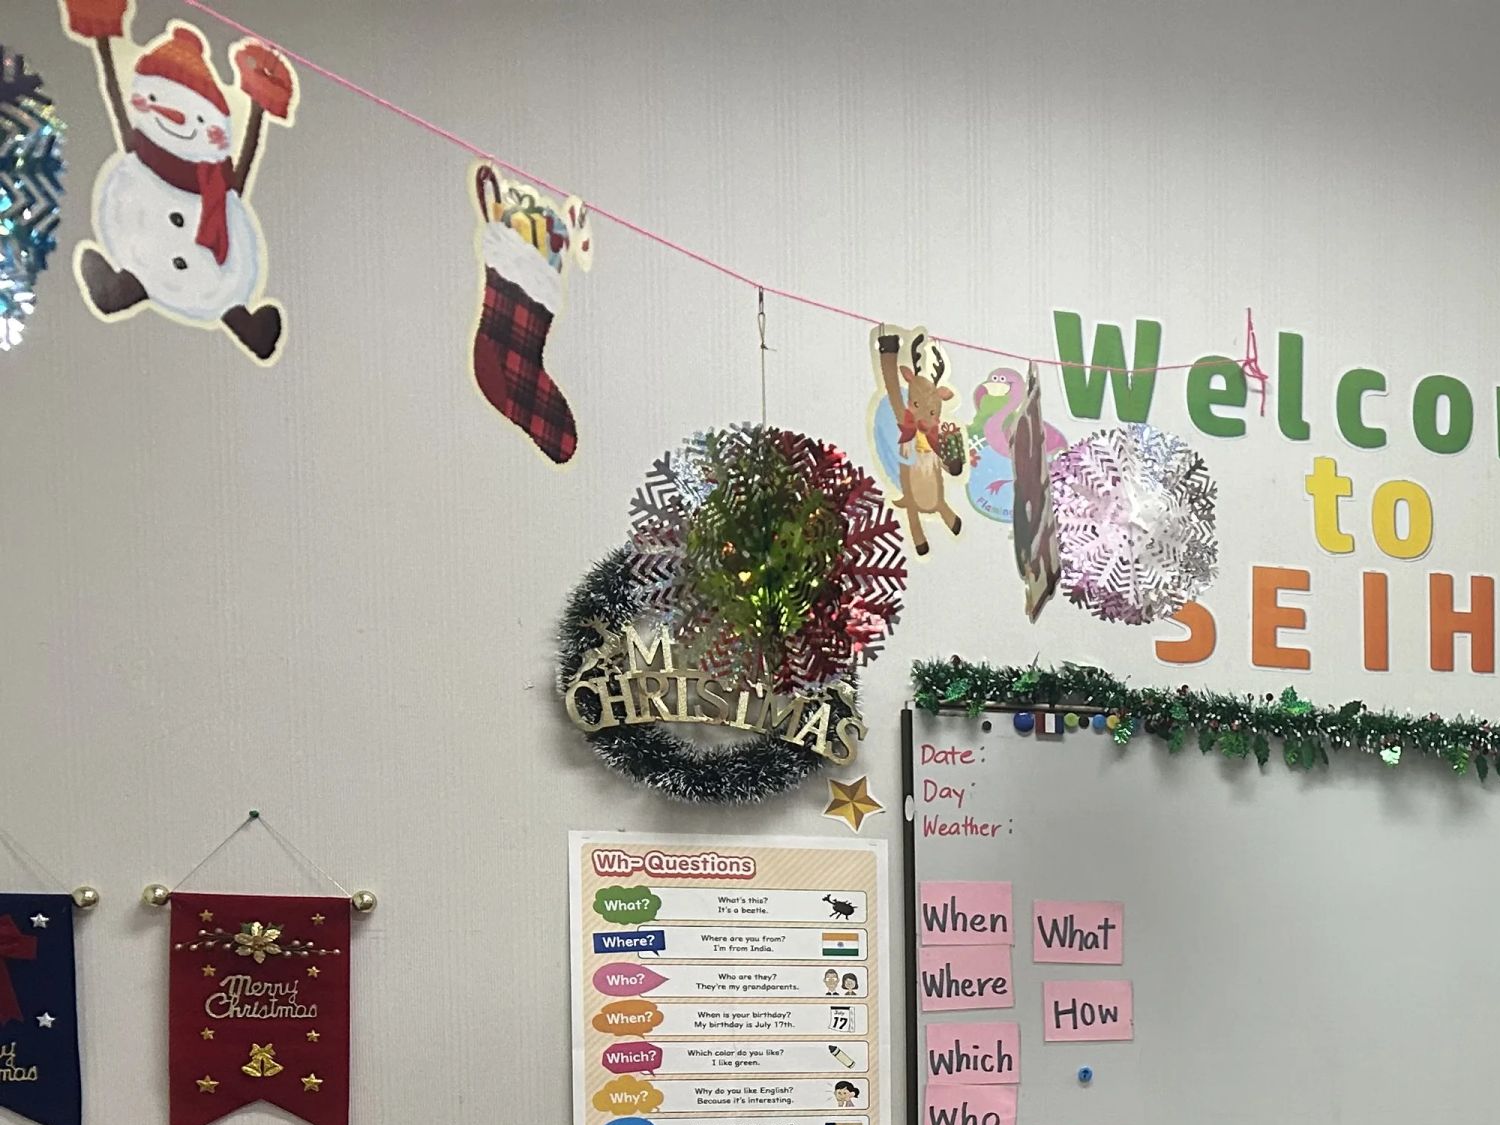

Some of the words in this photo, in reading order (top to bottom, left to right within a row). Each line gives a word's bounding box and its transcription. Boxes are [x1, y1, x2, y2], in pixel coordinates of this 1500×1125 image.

[1304, 456, 1434, 560] to
[604, 898, 650, 912] What?
[923, 896, 1007, 933] When
[762, 935, 786, 943] from?
[1037, 914, 1116, 951] What
[602, 934, 655, 948] Where?
[606, 973, 645, 987] Who?
[754, 973, 778, 982] they?
[922, 962, 1008, 998] Where
[219, 975, 299, 1003] Merry
[695, 983, 727, 992] They're
[728, 984, 741, 992] my
[742, 983, 800, 992] grandparents.
[204, 993, 318, 1019] Christmas
[606, 1011, 653, 1025] When?
[697, 1011, 721, 1019] When
[752, 1011, 792, 1020] birthday?
[1054, 998, 1118, 1029] How
[694, 1021, 707, 1030] My
[708, 1021, 744, 1030] birthday
[745, 1021, 753, 1029] is
[754, 1021, 772, 1030] July
[833, 1016, 848, 1030] 17
[606, 1050, 657, 1065] Which?
[687, 1049, 713, 1057] Which
[736, 1049, 748, 1057] do
[930, 1039, 1013, 1075] Which
[734, 1060, 761, 1068] green.
[609, 1090, 649, 1105] Why?
[694, 1087, 713, 1096] Why
[714, 1087, 725, 1095] do
[759, 1086, 794, 1096] English?
[696, 1097, 732, 1105] Because
[747, 1097, 794, 1105] interesting.
